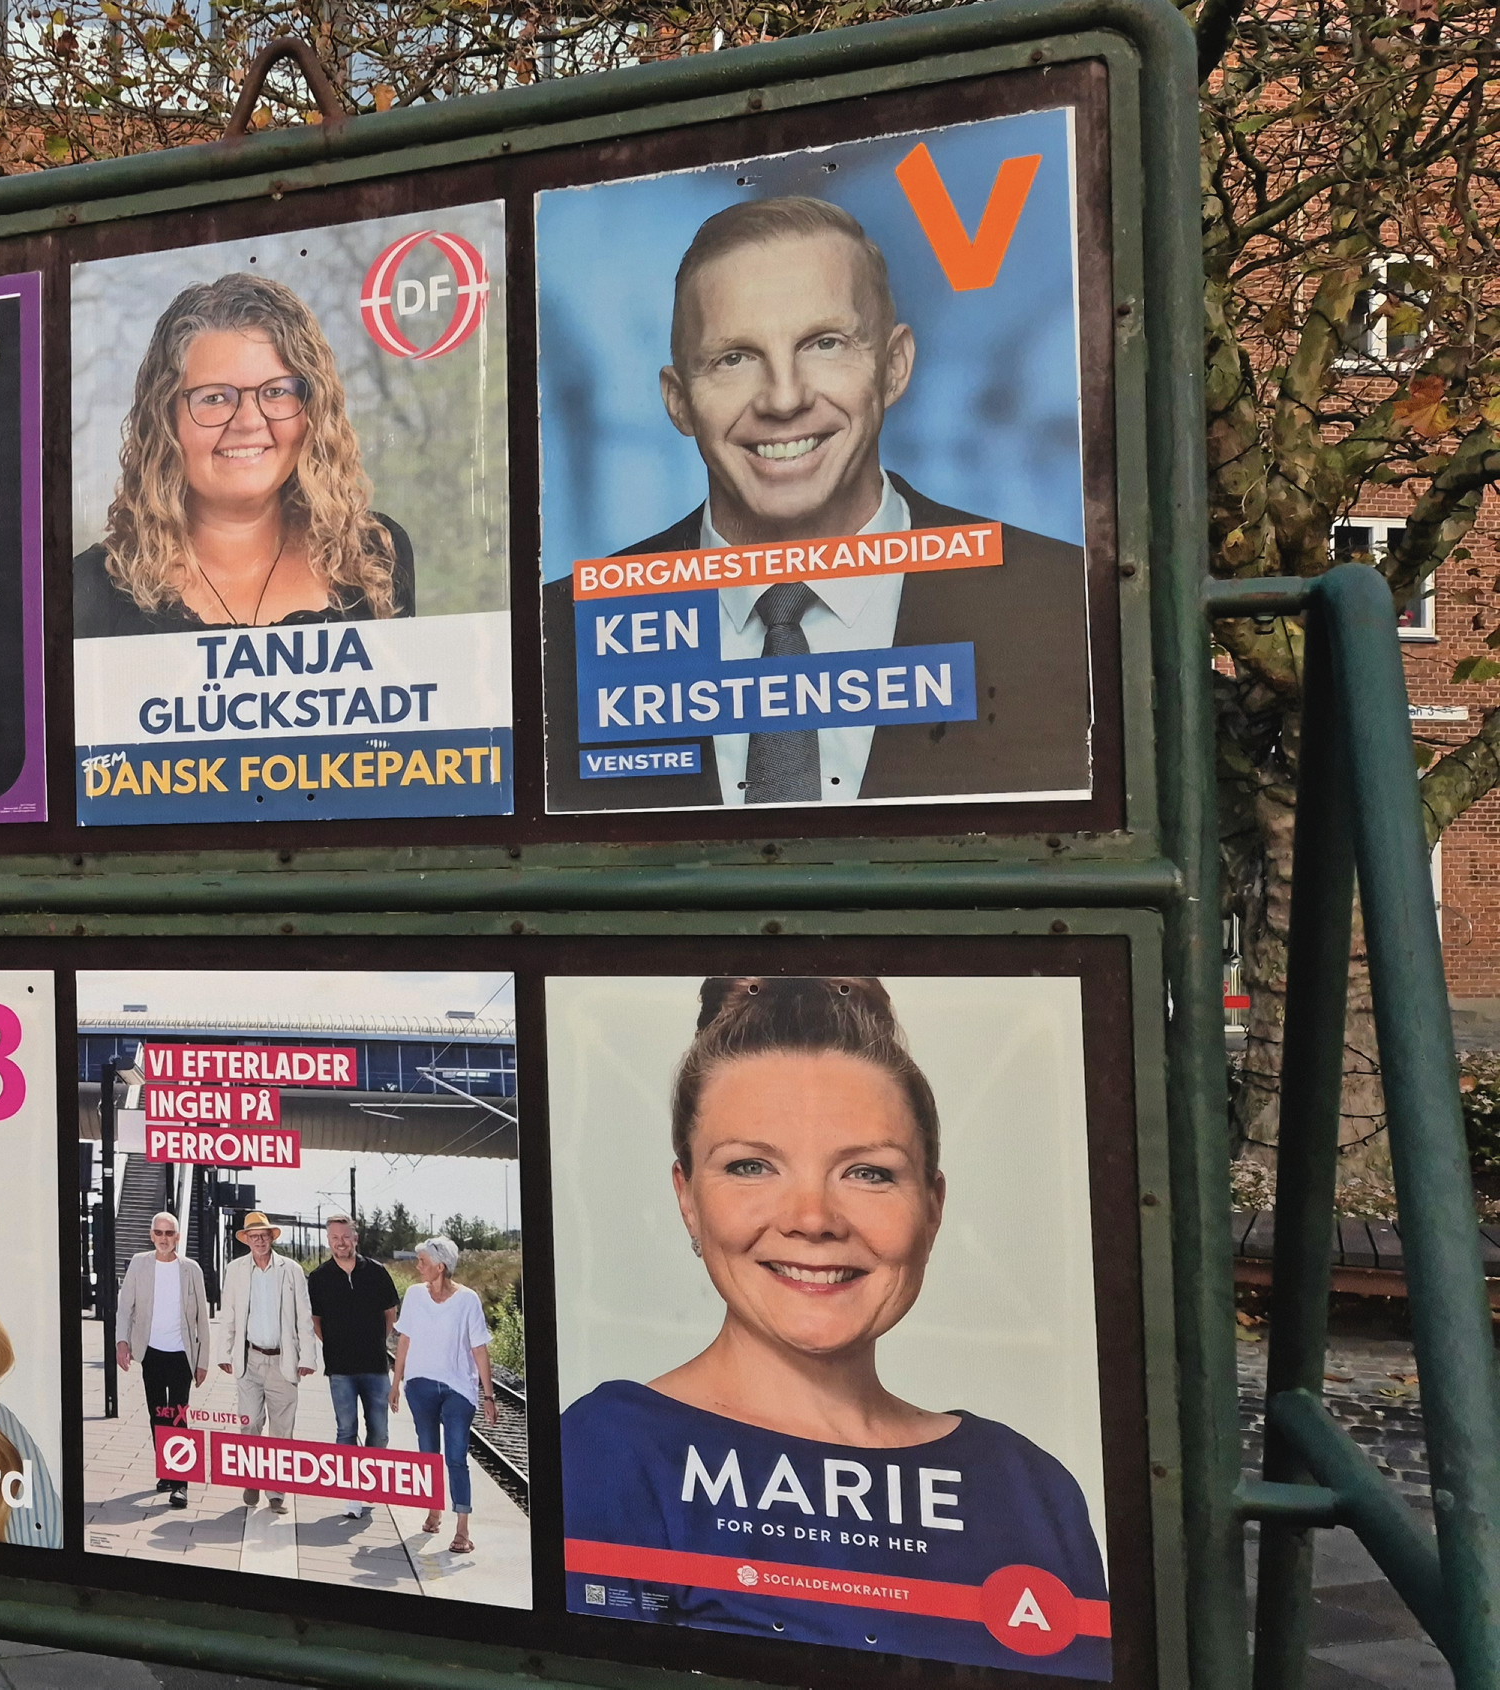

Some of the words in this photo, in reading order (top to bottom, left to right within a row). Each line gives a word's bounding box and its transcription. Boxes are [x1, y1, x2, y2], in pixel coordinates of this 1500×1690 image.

[895, 142, 1043, 292] V
[397, 274, 451, 316] DF
[580, 529, 993, 592] BORGMESTERKANDIDAT
[197, 627, 374, 680] TANJA
[595, 607, 700, 656] KEN
[138, 682, 438, 735] GLÜCKSTADT
[597, 663, 953, 728] KRISTENSEN
[81, 751, 127, 773] STEM
[85, 757, 229, 797] DANSK
[240, 747, 501, 792] FOLKEPARTI
[586, 751, 694, 772] VENSTRE
[149, 1049, 173, 1077] VI
[182, 1050, 351, 1083] EFTERLADER
[151, 1090, 231, 1120] INGEN
[241, 1089, 275, 1122] PÅ
[151, 1130, 294, 1165] PERRONEN
[156, 1405, 176, 1419] SÆT
[190, 1409, 210, 1422] VED
[212, 1411, 238, 1425] LISTE
[162, 1435, 198, 1473] Ø
[221, 1442, 434, 1499] ENHEDSLISTEN
[681, 1444, 965, 1532] MARIE
[717, 1518, 754, 1535] FOR
[761, 1524, 787, 1539] OS
[794, 1526, 832, 1544] DER
[840, 1531, 880, 1549] BOR
[888, 1537, 929, 1555] HER
[763, 1572, 911, 1601] SOCIALDEMOKRATIET
[1007, 1586, 1052, 1632] A
